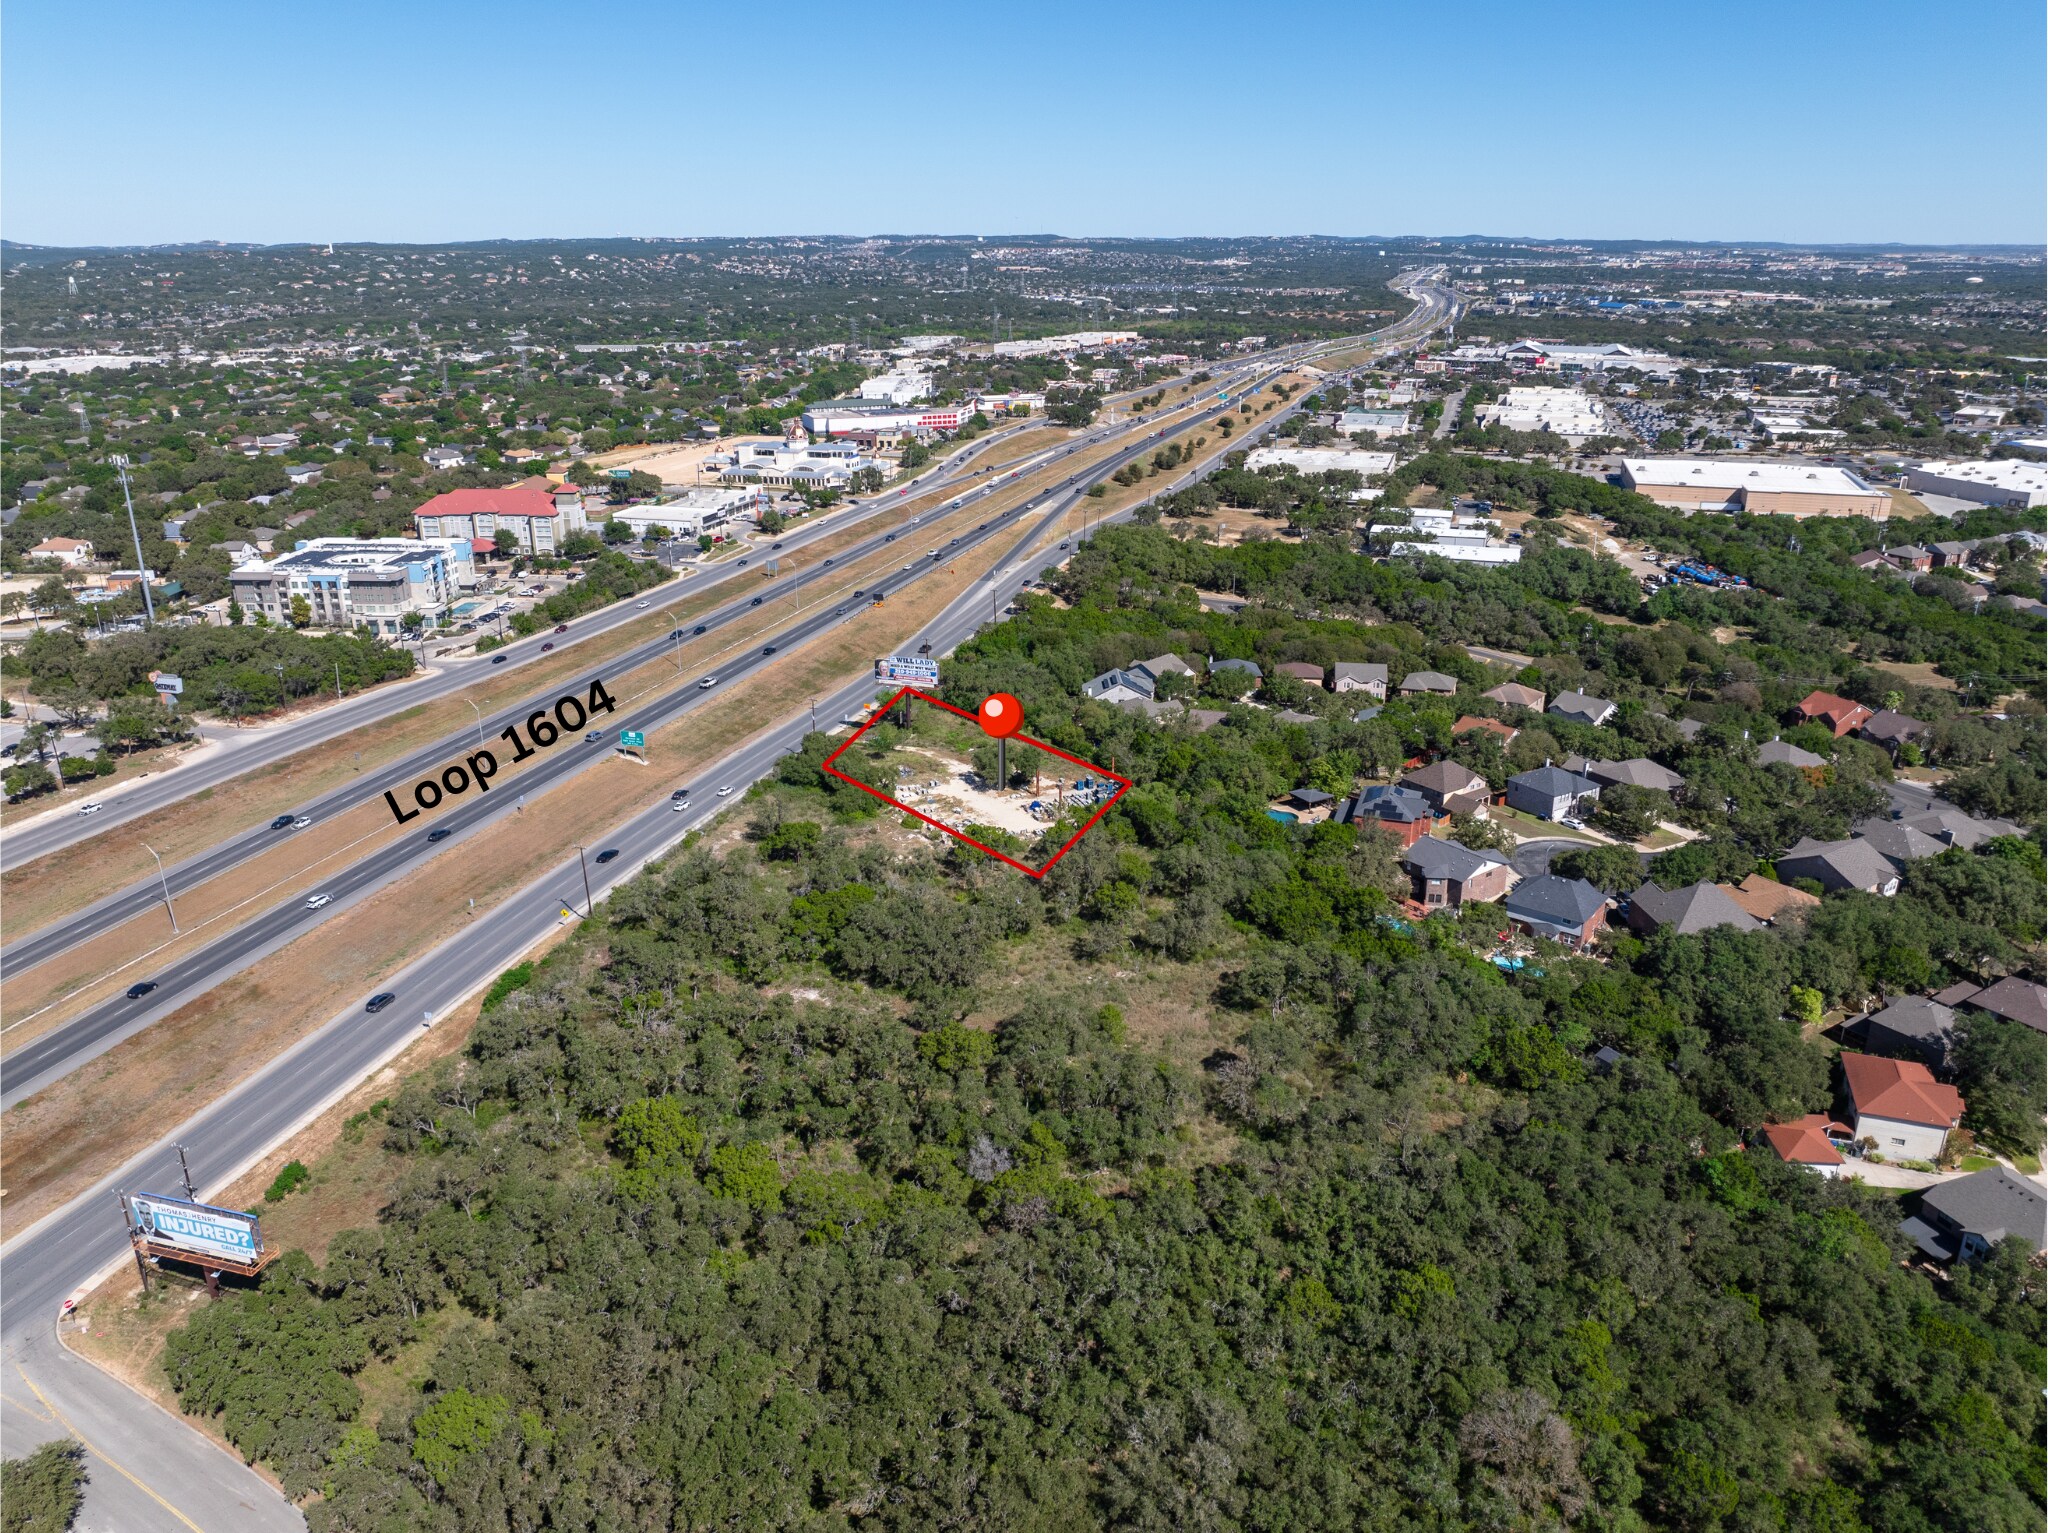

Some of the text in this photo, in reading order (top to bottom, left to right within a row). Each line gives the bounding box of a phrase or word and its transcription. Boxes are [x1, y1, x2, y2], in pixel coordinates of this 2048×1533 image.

[157, 1206, 187, 1217] THOMAS
[192, 1213, 216, 1224] HENRY
[158, 1214, 249, 1246] INJURED?
[221, 1244, 252, 1256] CALL 24/7
